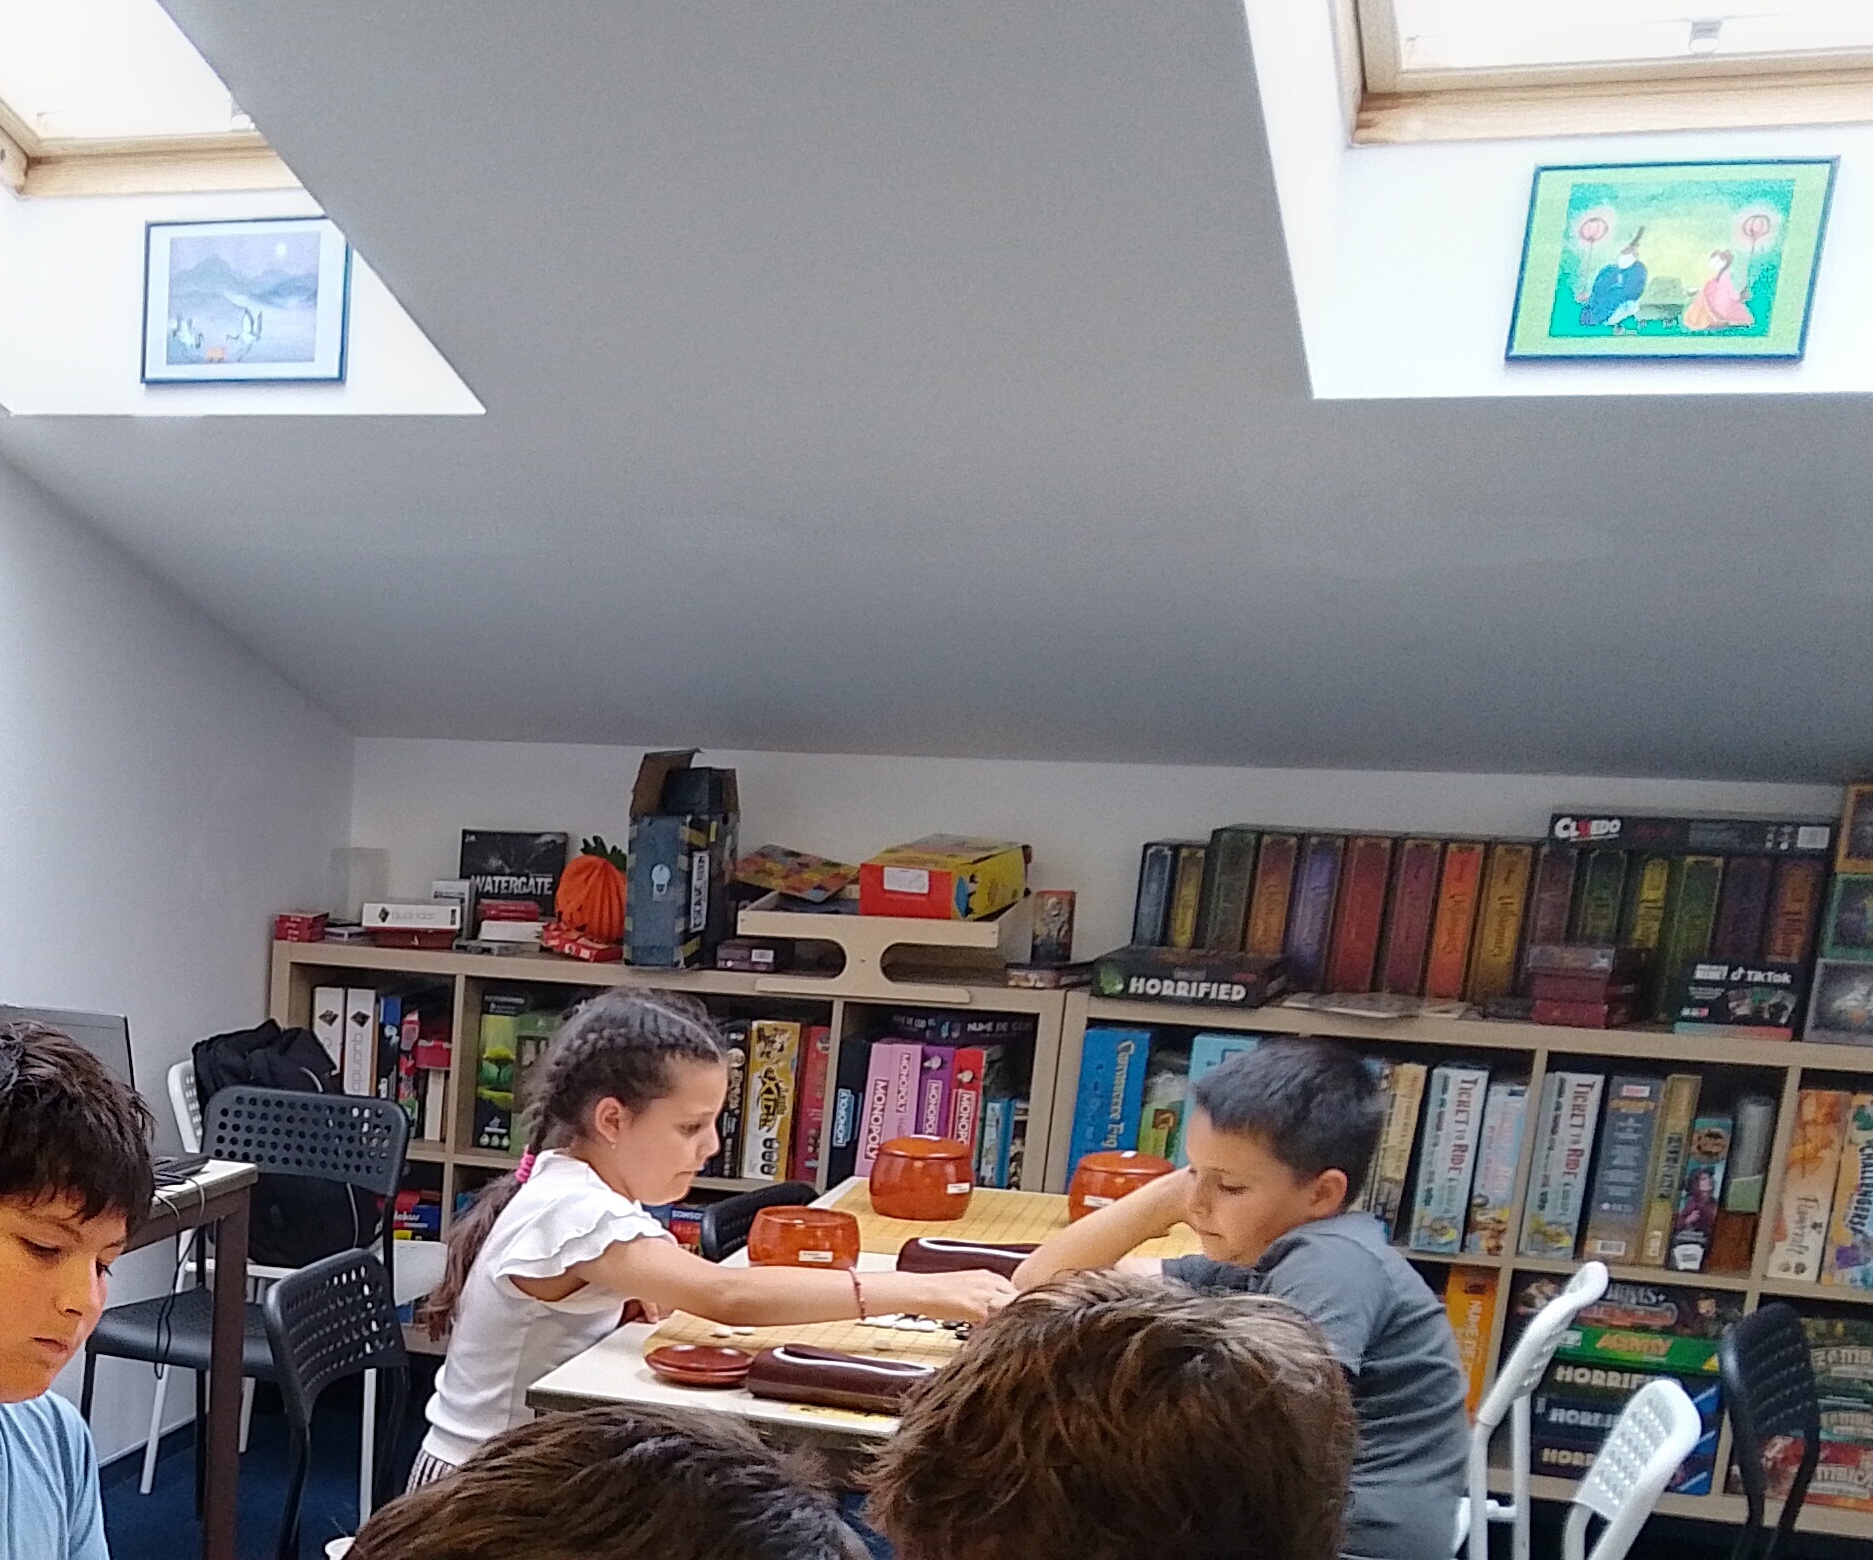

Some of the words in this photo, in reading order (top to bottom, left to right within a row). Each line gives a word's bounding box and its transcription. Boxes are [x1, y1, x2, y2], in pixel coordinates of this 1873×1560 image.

[1554, 817, 1622, 840] CLUEDO
[469, 874, 553, 896] WATERGATE
[1128, 976, 1246, 1001] HORRIFIED
[1747, 970, 1792, 984] TikTok
[896, 1053, 911, 1113] MONOPOLY
[835, 1091, 849, 1144] MONOPOLY
[926, 1082, 941, 1134] MONOPOL
[1454, 1077, 1478, 1126] TICKET
[1570, 1081, 1596, 1129] TICKET
[866, 1079, 888, 1159] MONOPOLY
[957, 1092, 973, 1145] MONOPO
[1448, 1144, 1469, 1175] RIDE
[1563, 1147, 1585, 1179] RIDE
[1597, 1333, 1673, 1356] ACTIVITY
[1554, 1365, 1650, 1389] HORRIF
